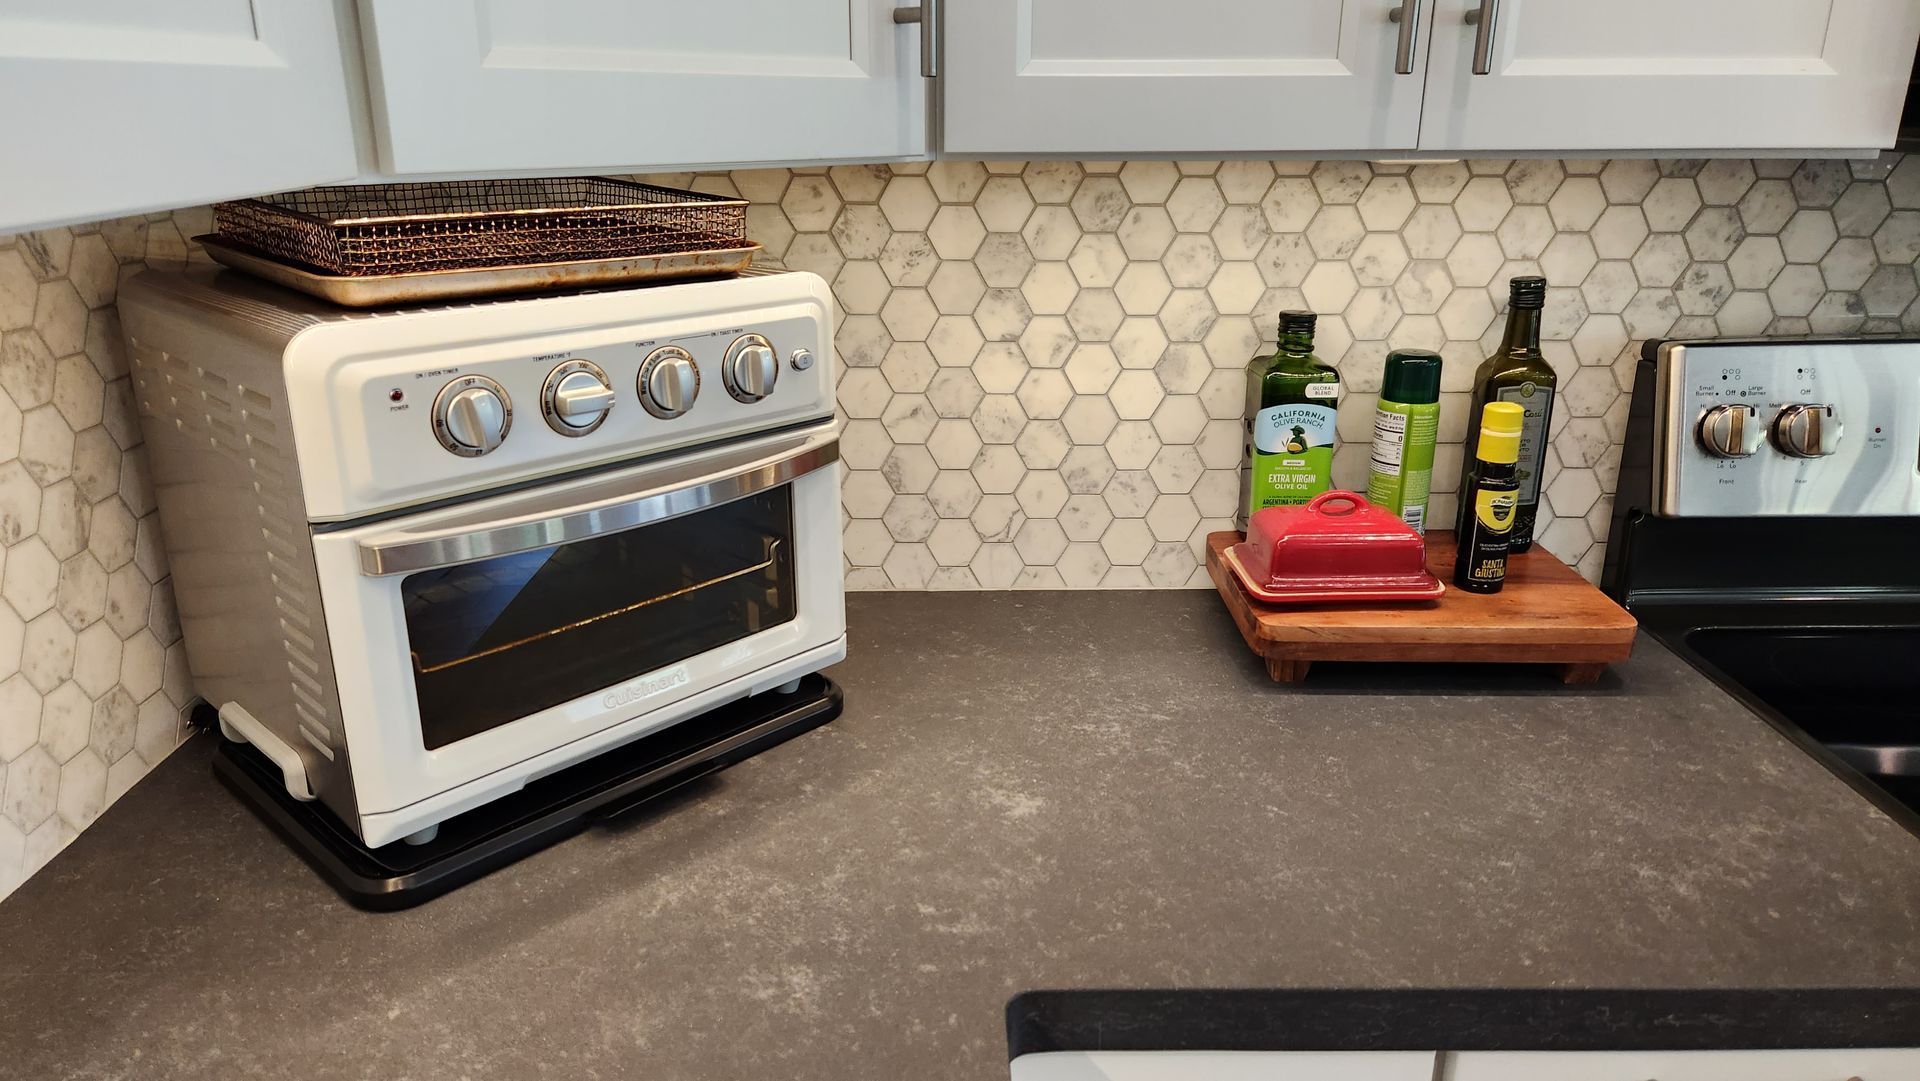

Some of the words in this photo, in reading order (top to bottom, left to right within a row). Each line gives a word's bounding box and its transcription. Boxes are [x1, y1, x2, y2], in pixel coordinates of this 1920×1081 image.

[390, 404, 409, 412] POWER
[1271, 410, 1325, 422] CALIFORNIA
[1389, 413, 1405, 421] Facts
[1273, 418, 1295, 428] OLIVE
[1296, 417, 1323, 429] RANCH
[1268, 473, 1290, 483] EXTRA
[1291, 473, 1316, 483] VIRGIN
[602, 668, 686, 709] Cuisinart
